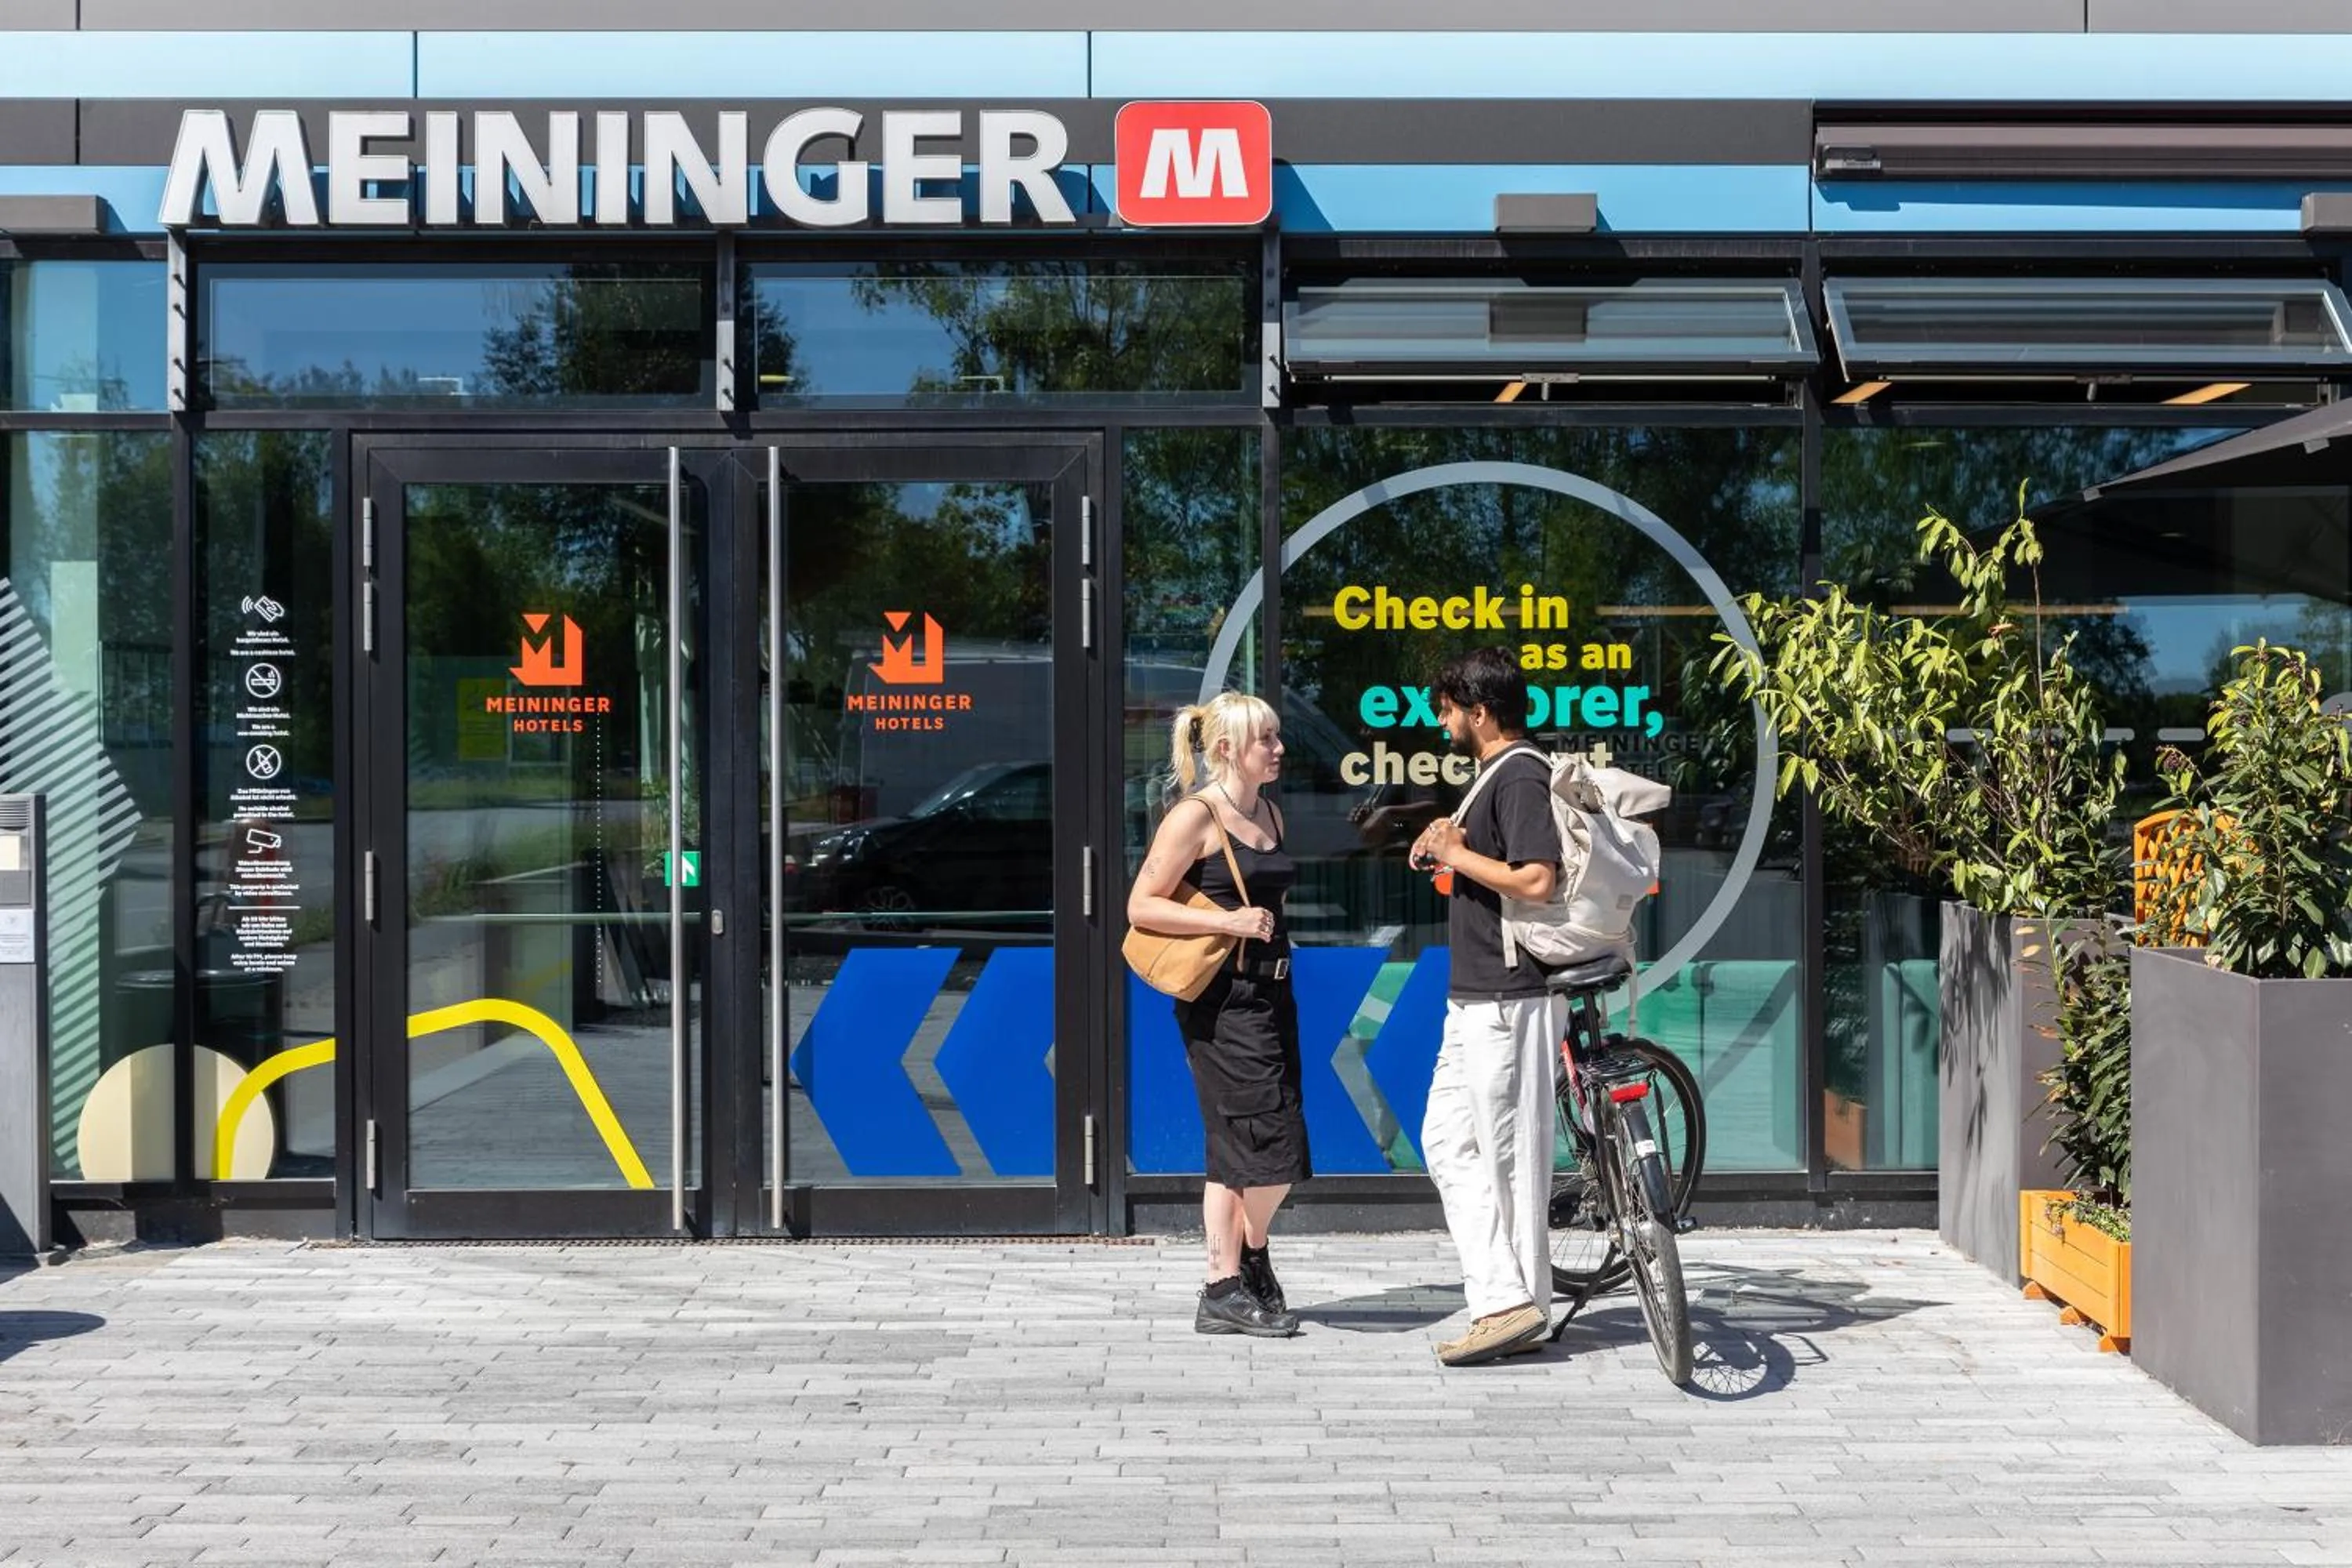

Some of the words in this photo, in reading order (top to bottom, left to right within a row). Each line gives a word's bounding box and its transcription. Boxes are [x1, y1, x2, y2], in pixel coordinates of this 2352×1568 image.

[158, 108, 1077, 227] MEININGER
[1333, 586, 1505, 630] Check
[1519, 583, 1568, 629] in
[1520, 643, 1567, 670] as
[1581, 643, 1632, 670] an
[485, 696, 611, 713] MEININGER
[848, 695, 971, 710] MEININGER
[1360, 684, 1664, 739] exorer,
[514, 719, 583, 732] HOTELS
[875, 717, 943, 729] HOTELS
[1340, 742, 1478, 786] chec
